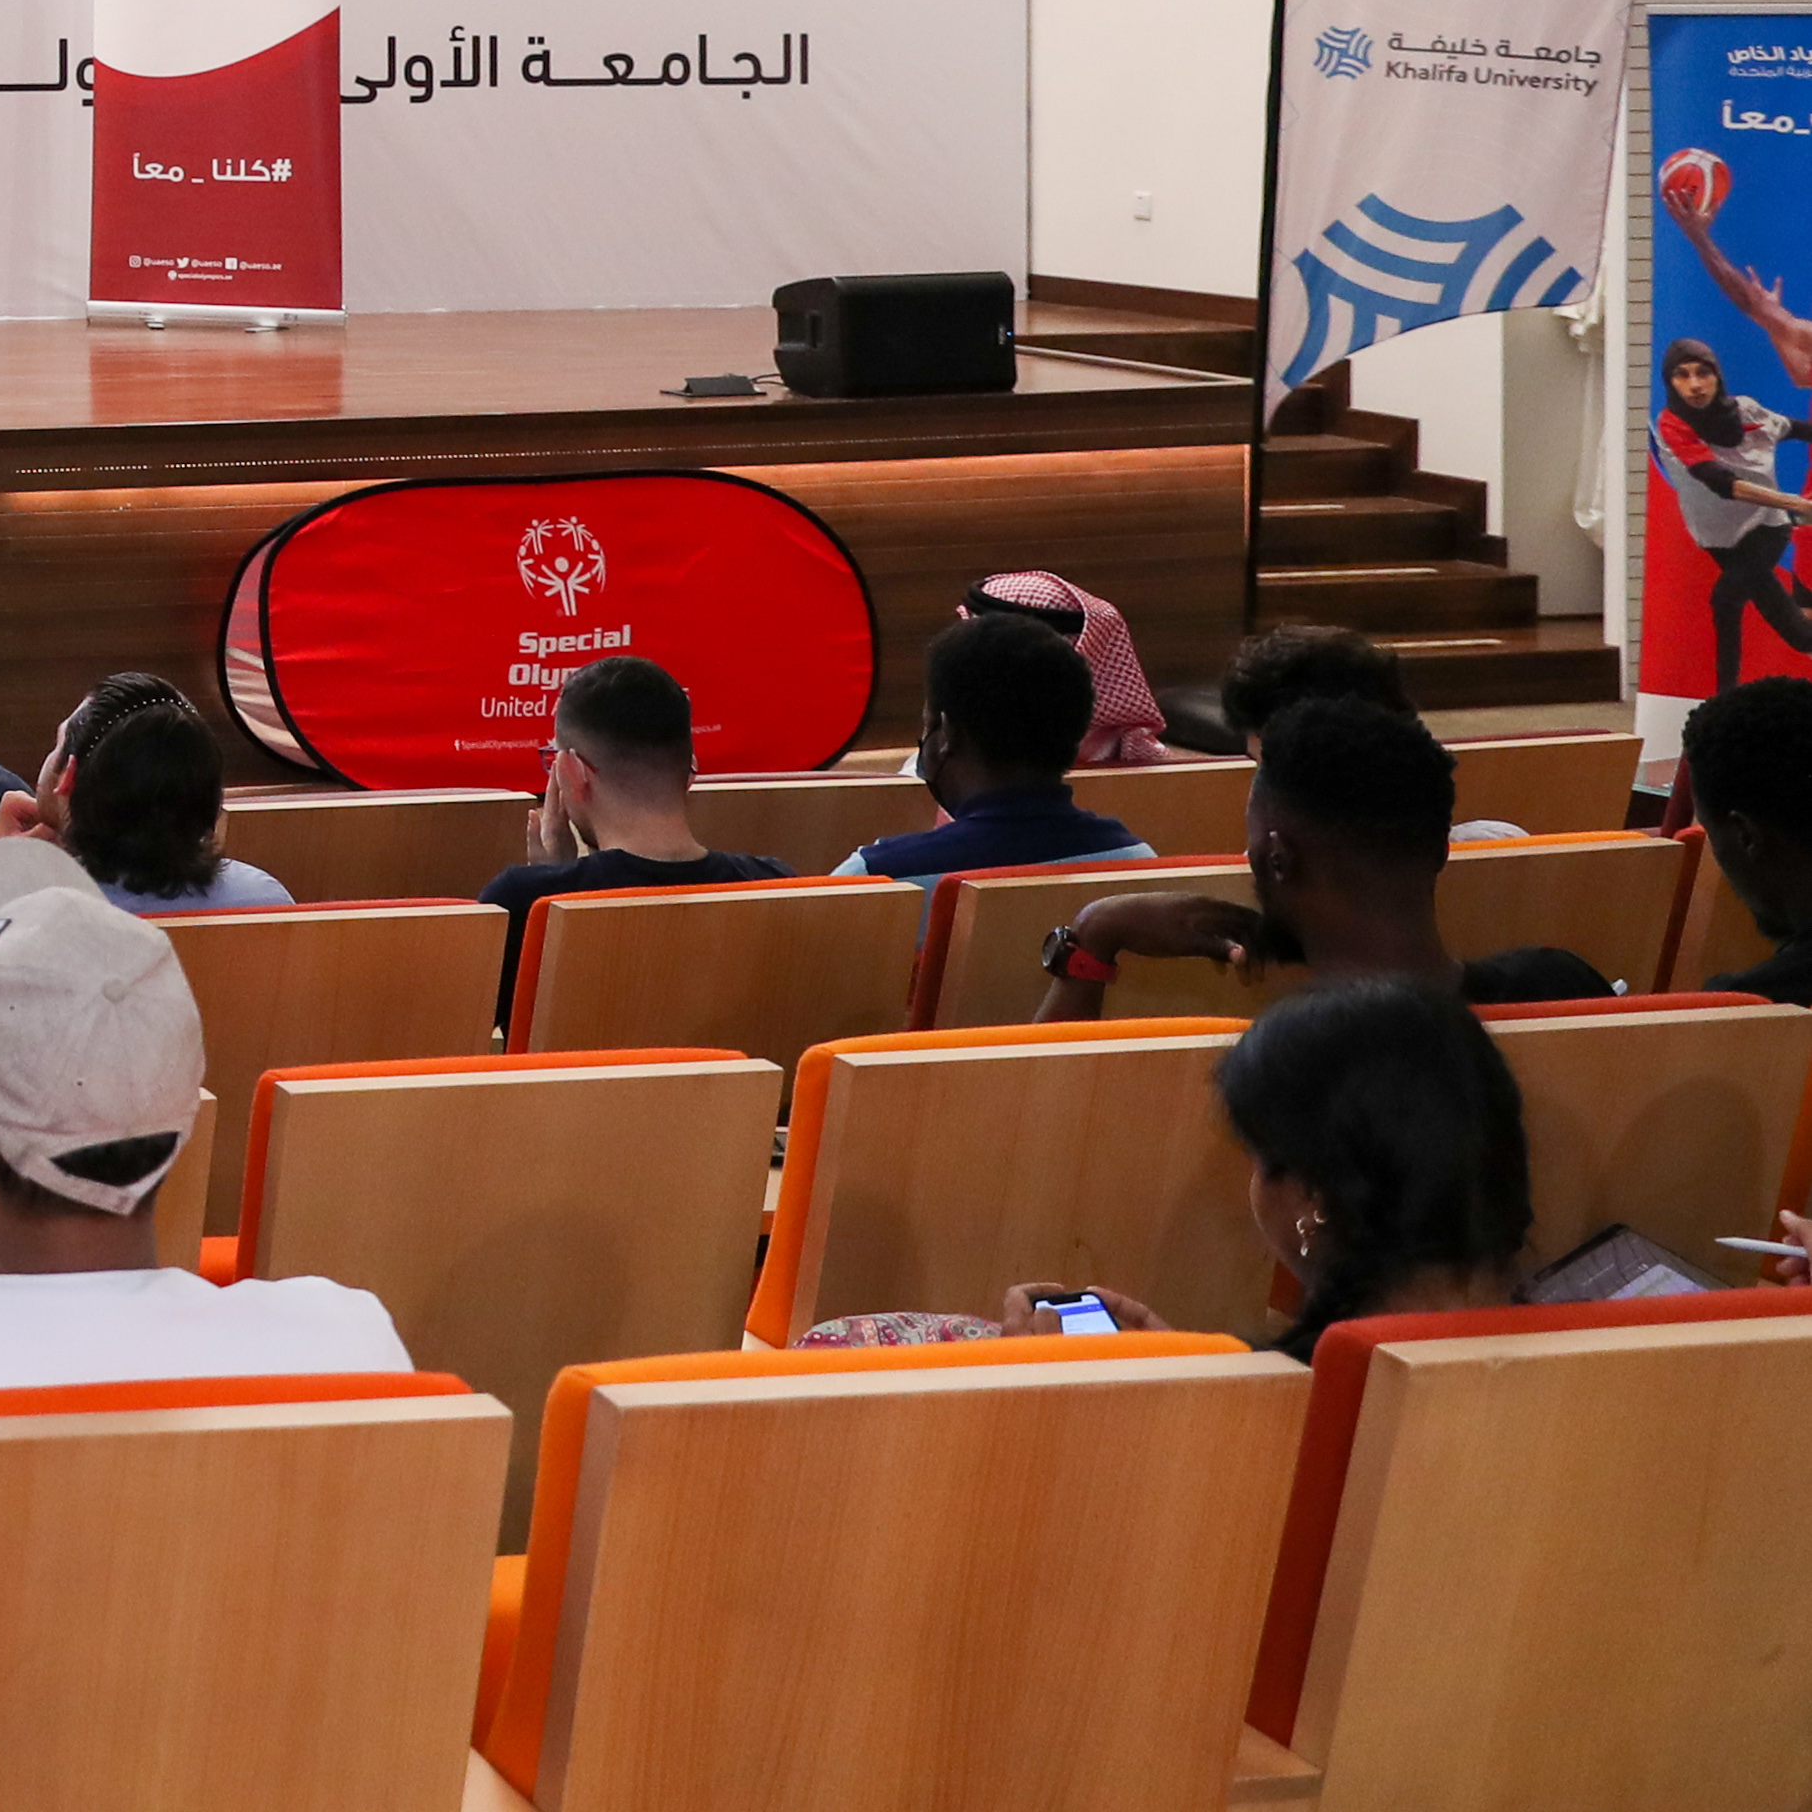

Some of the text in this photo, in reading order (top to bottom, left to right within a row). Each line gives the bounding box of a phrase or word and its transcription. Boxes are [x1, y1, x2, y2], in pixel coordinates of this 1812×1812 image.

[340, 25, 810, 104] الجامعة الأولى
[1386, 33, 1602, 68] جامعة خليفة
[1726, 45, 1786, 65] الخاص
[1385, 61, 1600, 97] Khalifa University
[518, 624, 631, 659] Special
[481, 694, 547, 718] United
